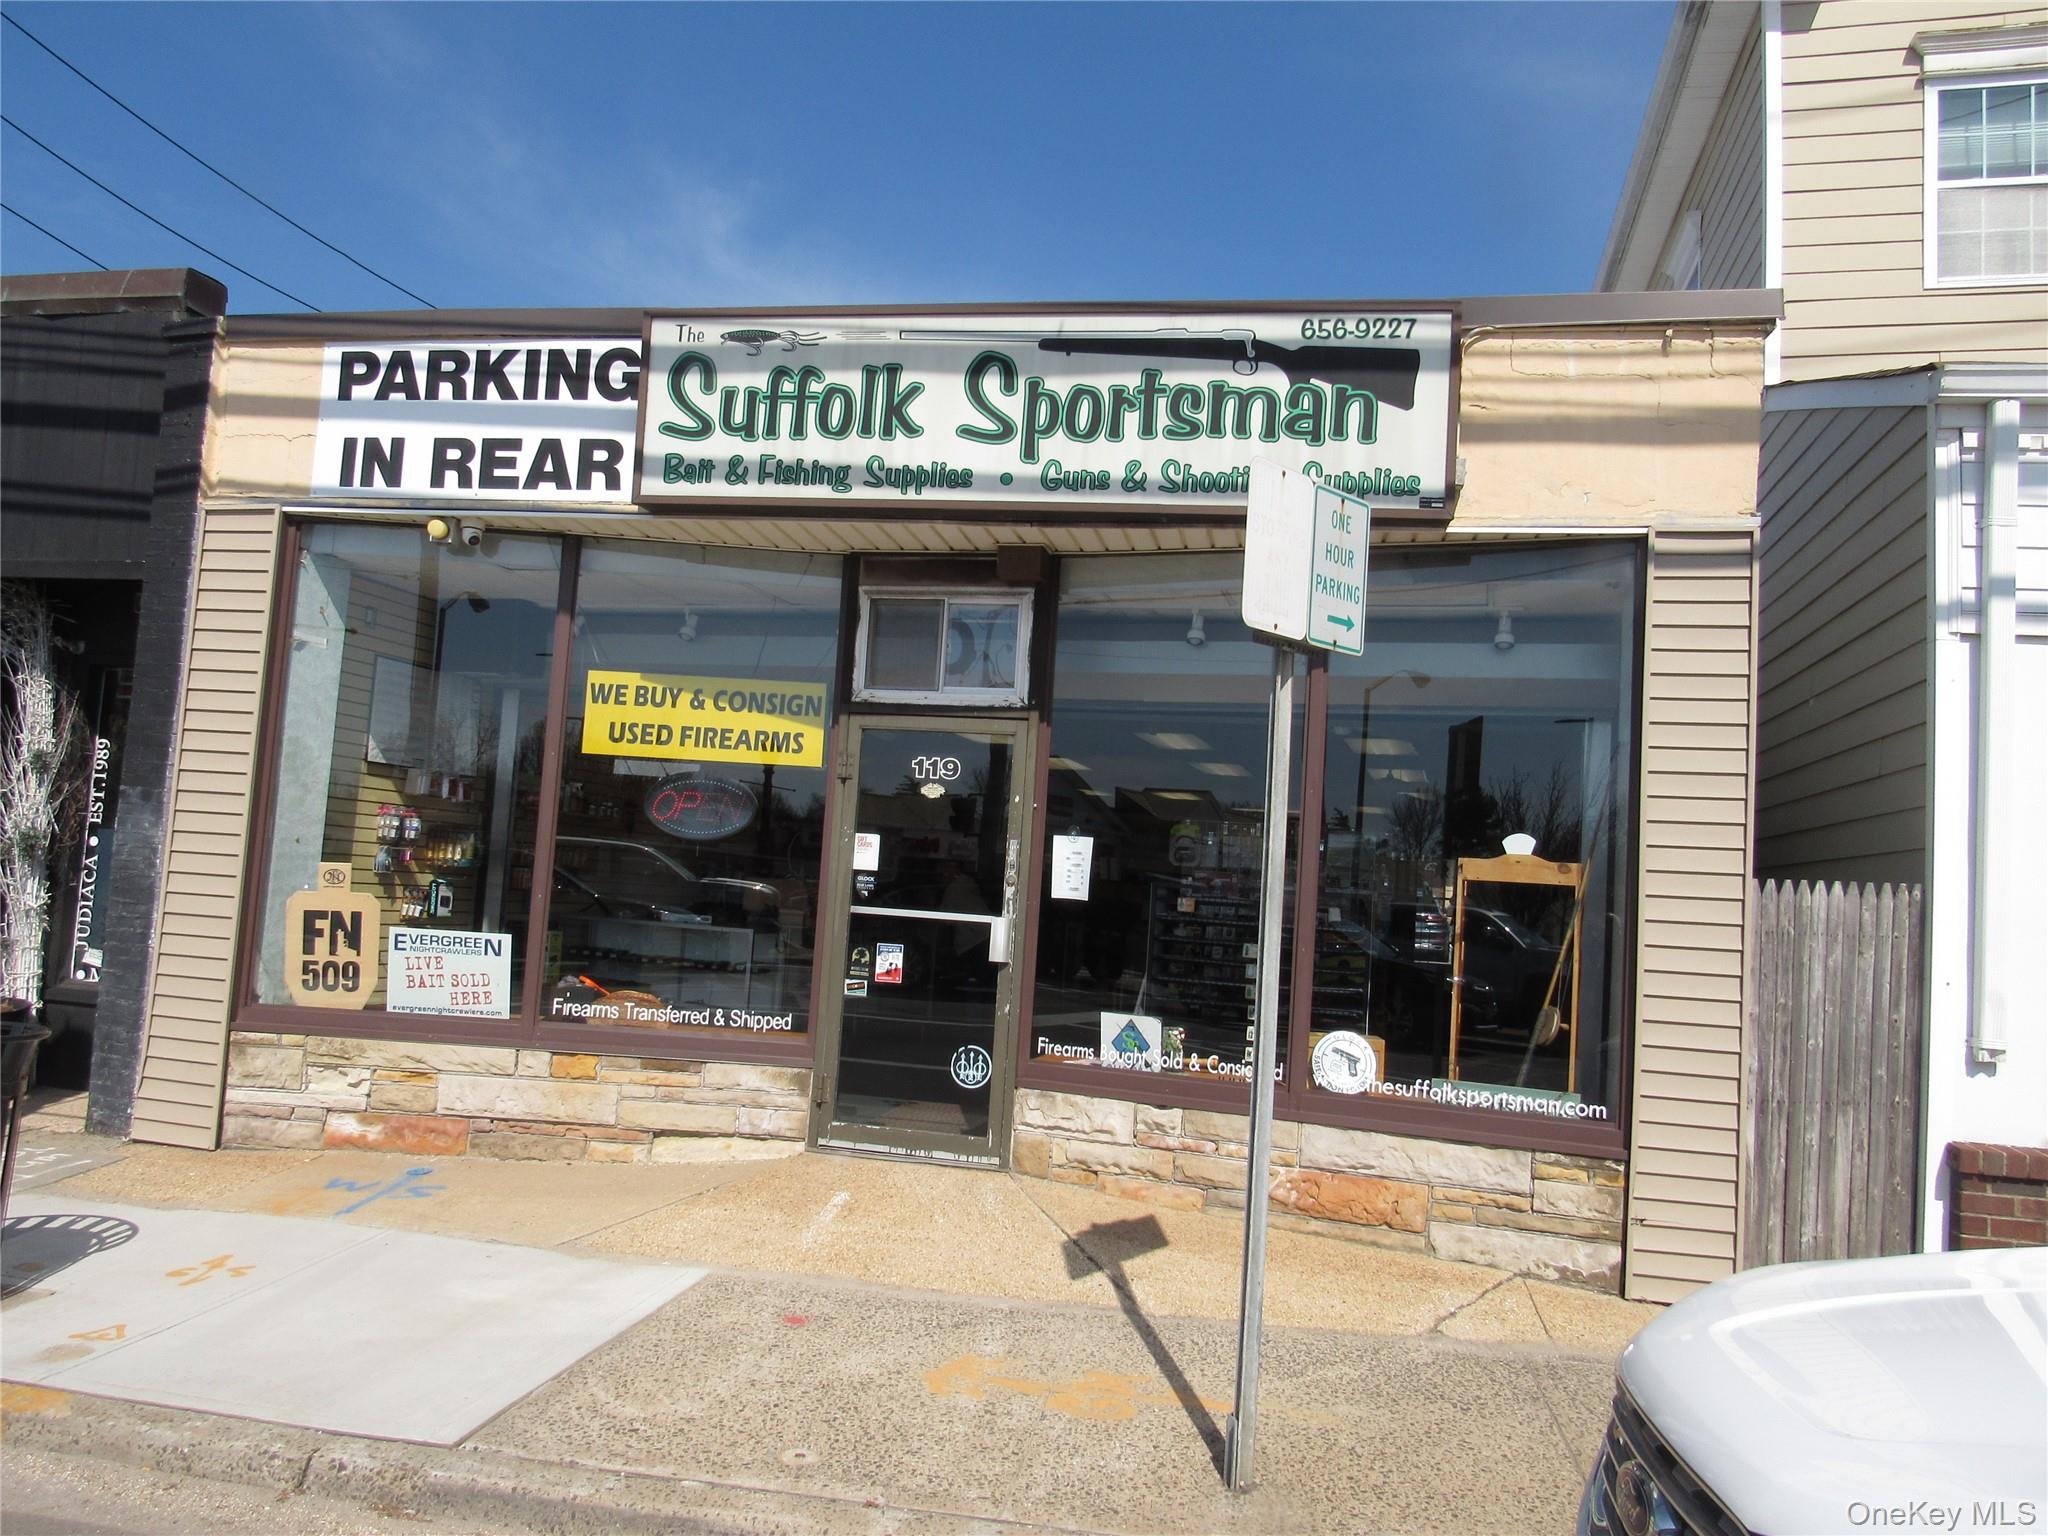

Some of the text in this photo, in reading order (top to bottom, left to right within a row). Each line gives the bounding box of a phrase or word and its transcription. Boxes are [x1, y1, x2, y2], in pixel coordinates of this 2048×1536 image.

[676, 324, 705, 343] The
[1301, 318, 1417, 340] 656-9227
[337, 347, 641, 402] PARKING
[658, 350, 1379, 464] Suffolk Sportsman
[339, 437, 624, 490] IN REAR
[663, 453, 974, 495] Bait & Fishing Supplies
[1040, 459, 1110, 492] Guns
[1121, 460, 1147, 492] &
[1158, 459, 1249, 493] Shooti
[1331, 510, 1352, 535] ONE
[1325, 542, 1355, 569] HOUR
[1315, 573, 1361, 606] PARKING
[590, 683, 823, 717] WE BUY & CONSIGN
[608, 722, 805, 754] USED FIREARMS
[911, 756, 961, 780] 119
[652, 787, 747, 821] OPEN
[76, 855, 99, 951] JUDIACA
[89, 738, 111, 824] EST.1989
[303, 909, 363, 957] FN
[394, 933, 502, 957] EVERGREEN
[404, 956, 444, 970] LIVE
[409, 945, 483, 956] NIGHTCRAWLERS
[302, 960, 361, 992] 509
[406, 973, 490, 988] BAIT SOLD
[449, 991, 493, 1005] HERE
[552, 998, 793, 1032] Firearms Transferred & Shipped
[1038, 1036, 1095, 1060] Firearms
[1152, 1048, 1184, 1070] Sold
[1189, 1052, 1201, 1072] &
[1207, 1055, 1284, 1082] Consigd
